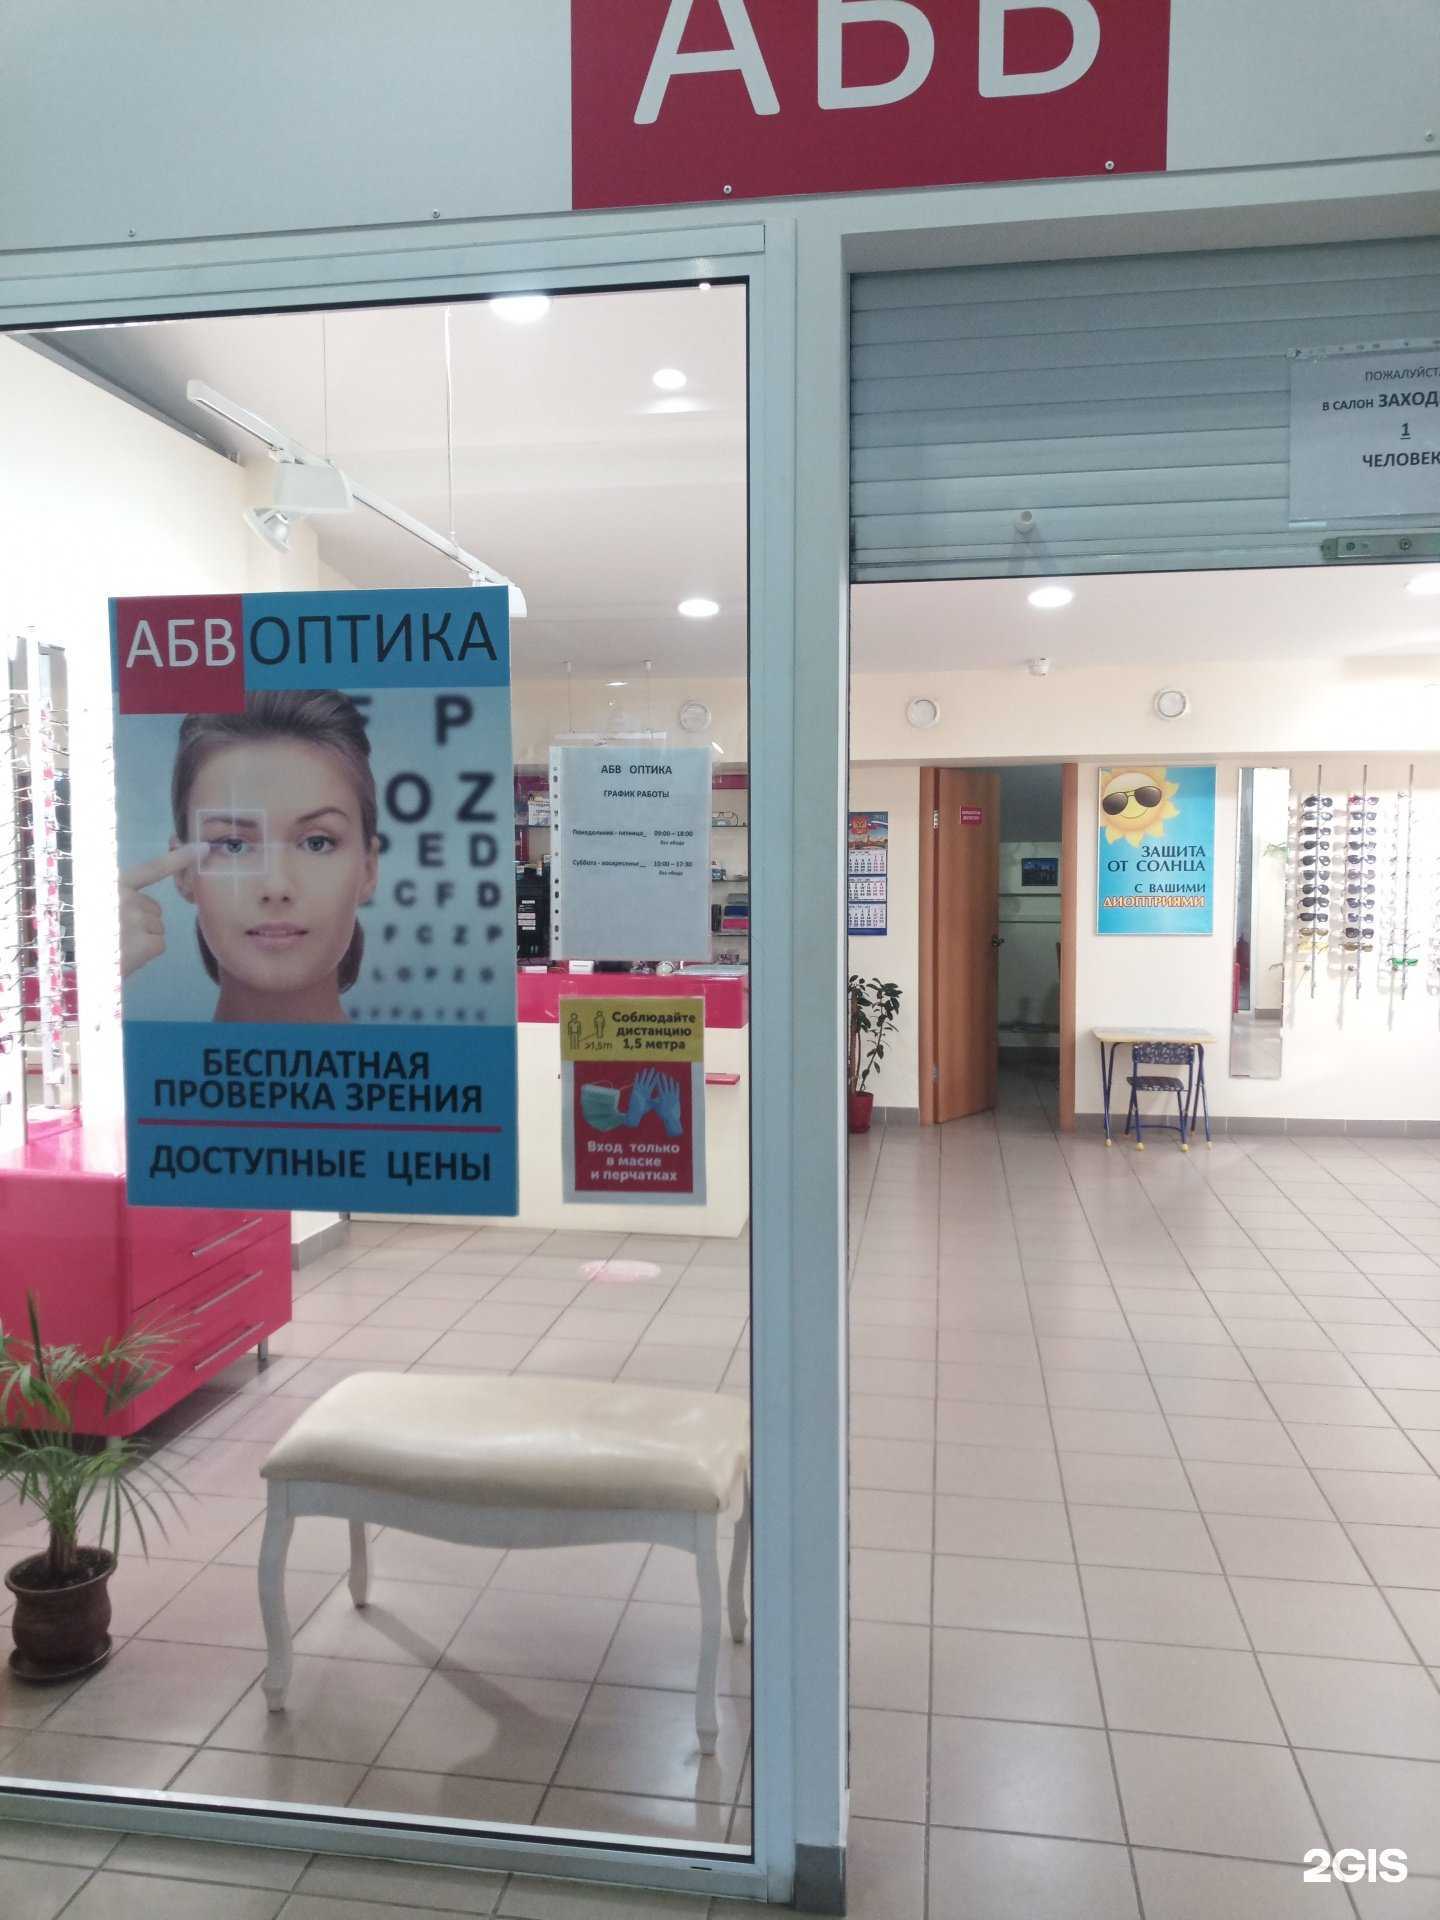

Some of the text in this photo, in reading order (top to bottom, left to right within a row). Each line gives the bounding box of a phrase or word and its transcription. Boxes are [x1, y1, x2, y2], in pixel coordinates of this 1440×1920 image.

[1365, 366, 1440, 382] ПОЖАЛУЙСТ
[1333, 398, 1374, 411] САЛОН
[1400, 422, 1411, 437] 1
[1362, 451, 1440, 468] ЧЕЛОВЕК
[126, 611, 498, 669] АБВ ОПТИКА
[601, 764, 673, 775] АБВ ОПТИКА
[603, 790, 670, 798] ГРАФИК РАБОТЫ
[1141, 845, 1206, 858] ЗАЩИТА
[1107, 859, 1206, 872] ОТ СОЛНЦА
[1149, 883, 1206, 893] ВАШИМИ
[1104, 895, 1206, 908] ДИОПТРИЯМИ
[612, 1011, 696, 1025] Соблюдайте
[616, 1025, 692, 1038] дистанцию
[623, 1039, 686, 1051] 1,5 метра
[203, 1048, 430, 1079] БЕСПЛАТНАЯ
[154, 1079, 483, 1114] ПРОВЕРКА ЗРЕНИЯ
[587, 1141, 681, 1154] Вход только
[149, 1144, 491, 1187] ДОСТУПНЫЕ ЦЕНЫ
[618, 1157, 662, 1167] маске
[603, 1170, 678, 1183] перчатках
